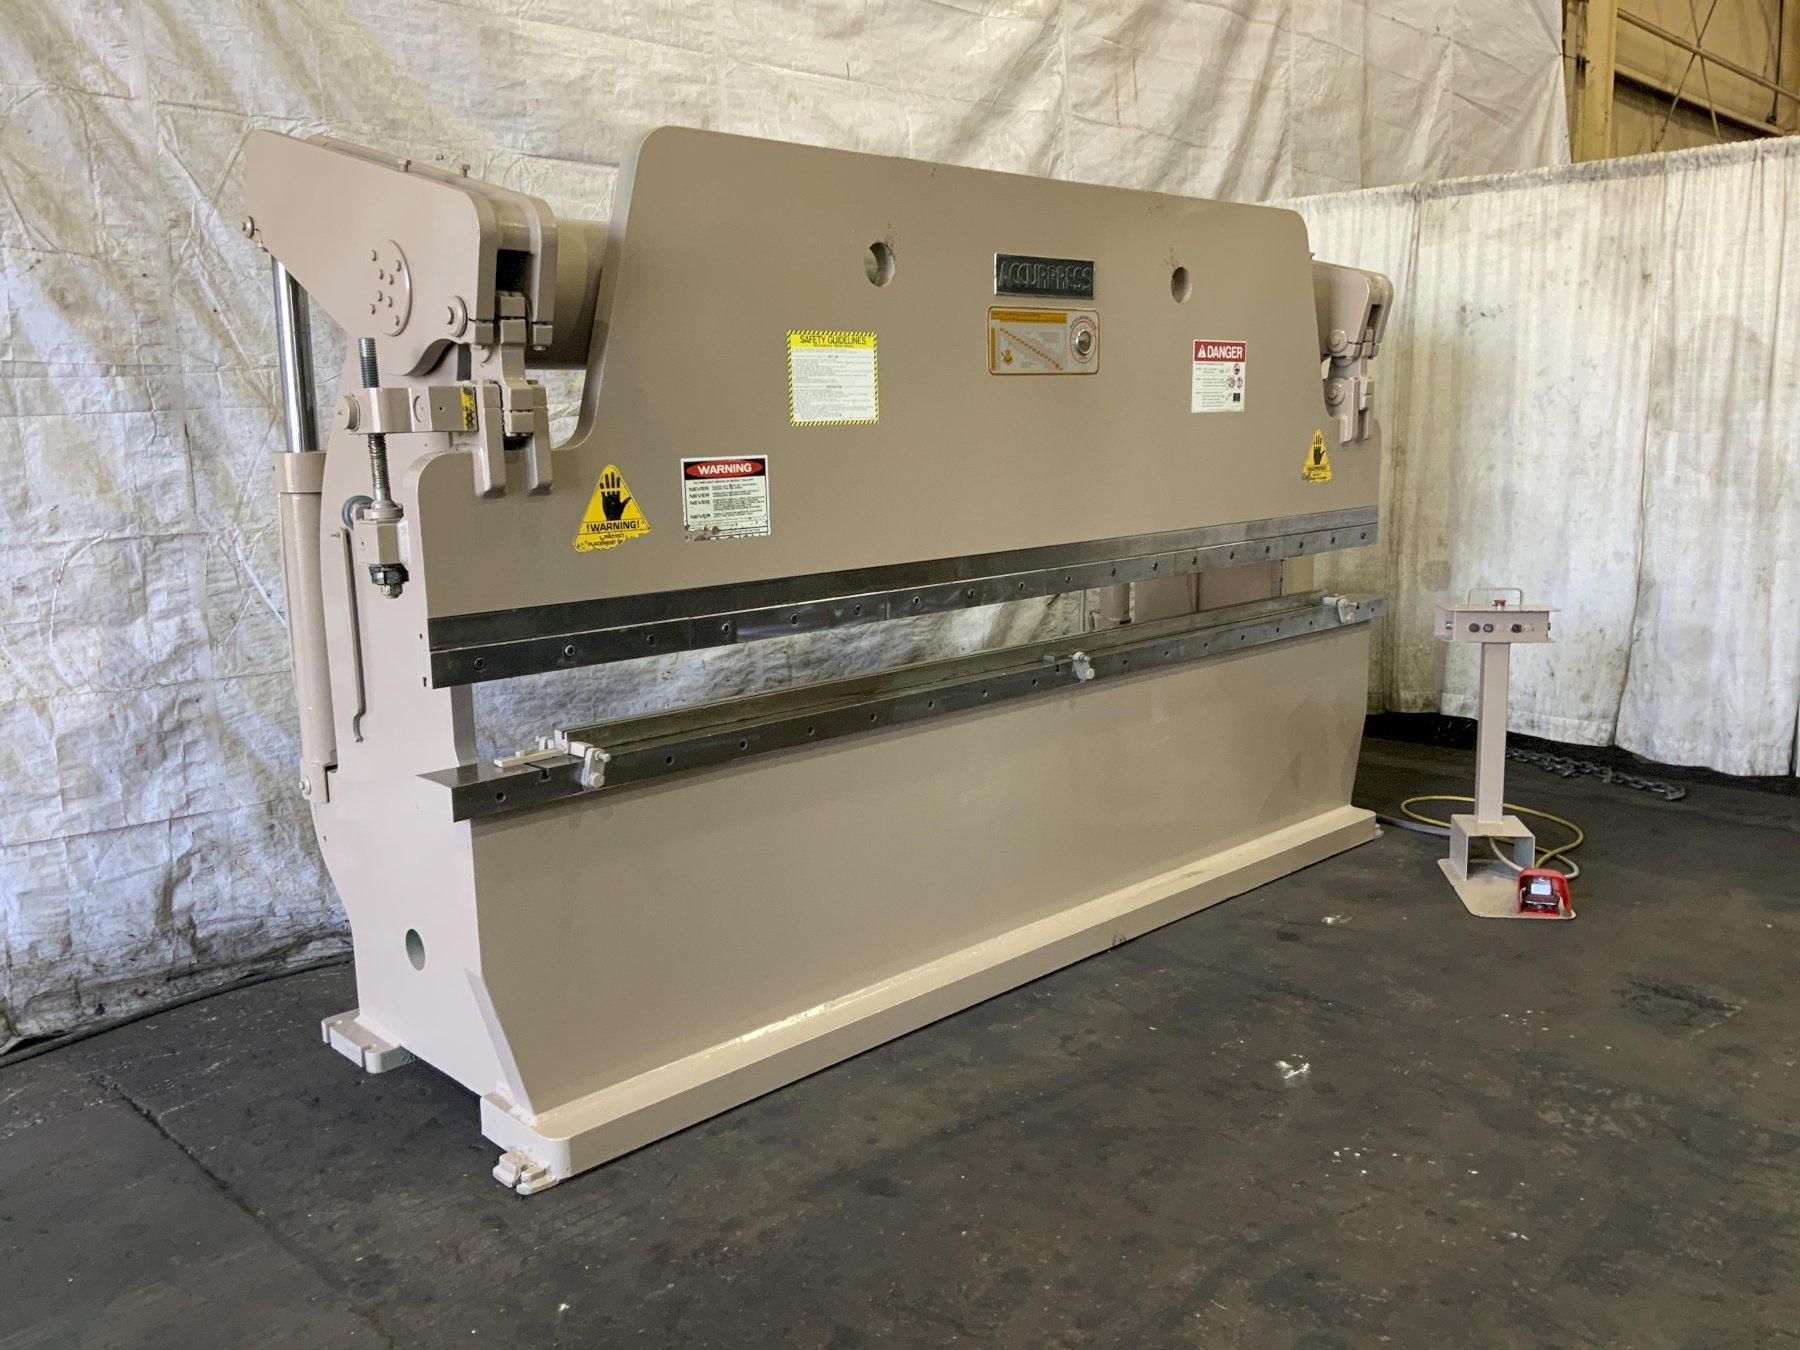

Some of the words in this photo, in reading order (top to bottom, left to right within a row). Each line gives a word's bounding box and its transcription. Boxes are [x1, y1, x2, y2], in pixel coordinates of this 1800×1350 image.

[800, 335, 825, 344] SAFETY
[828, 336, 867, 345] GUIDELINES
[1207, 345, 1243, 359] DANGER
[697, 463, 752, 475] WARNING
